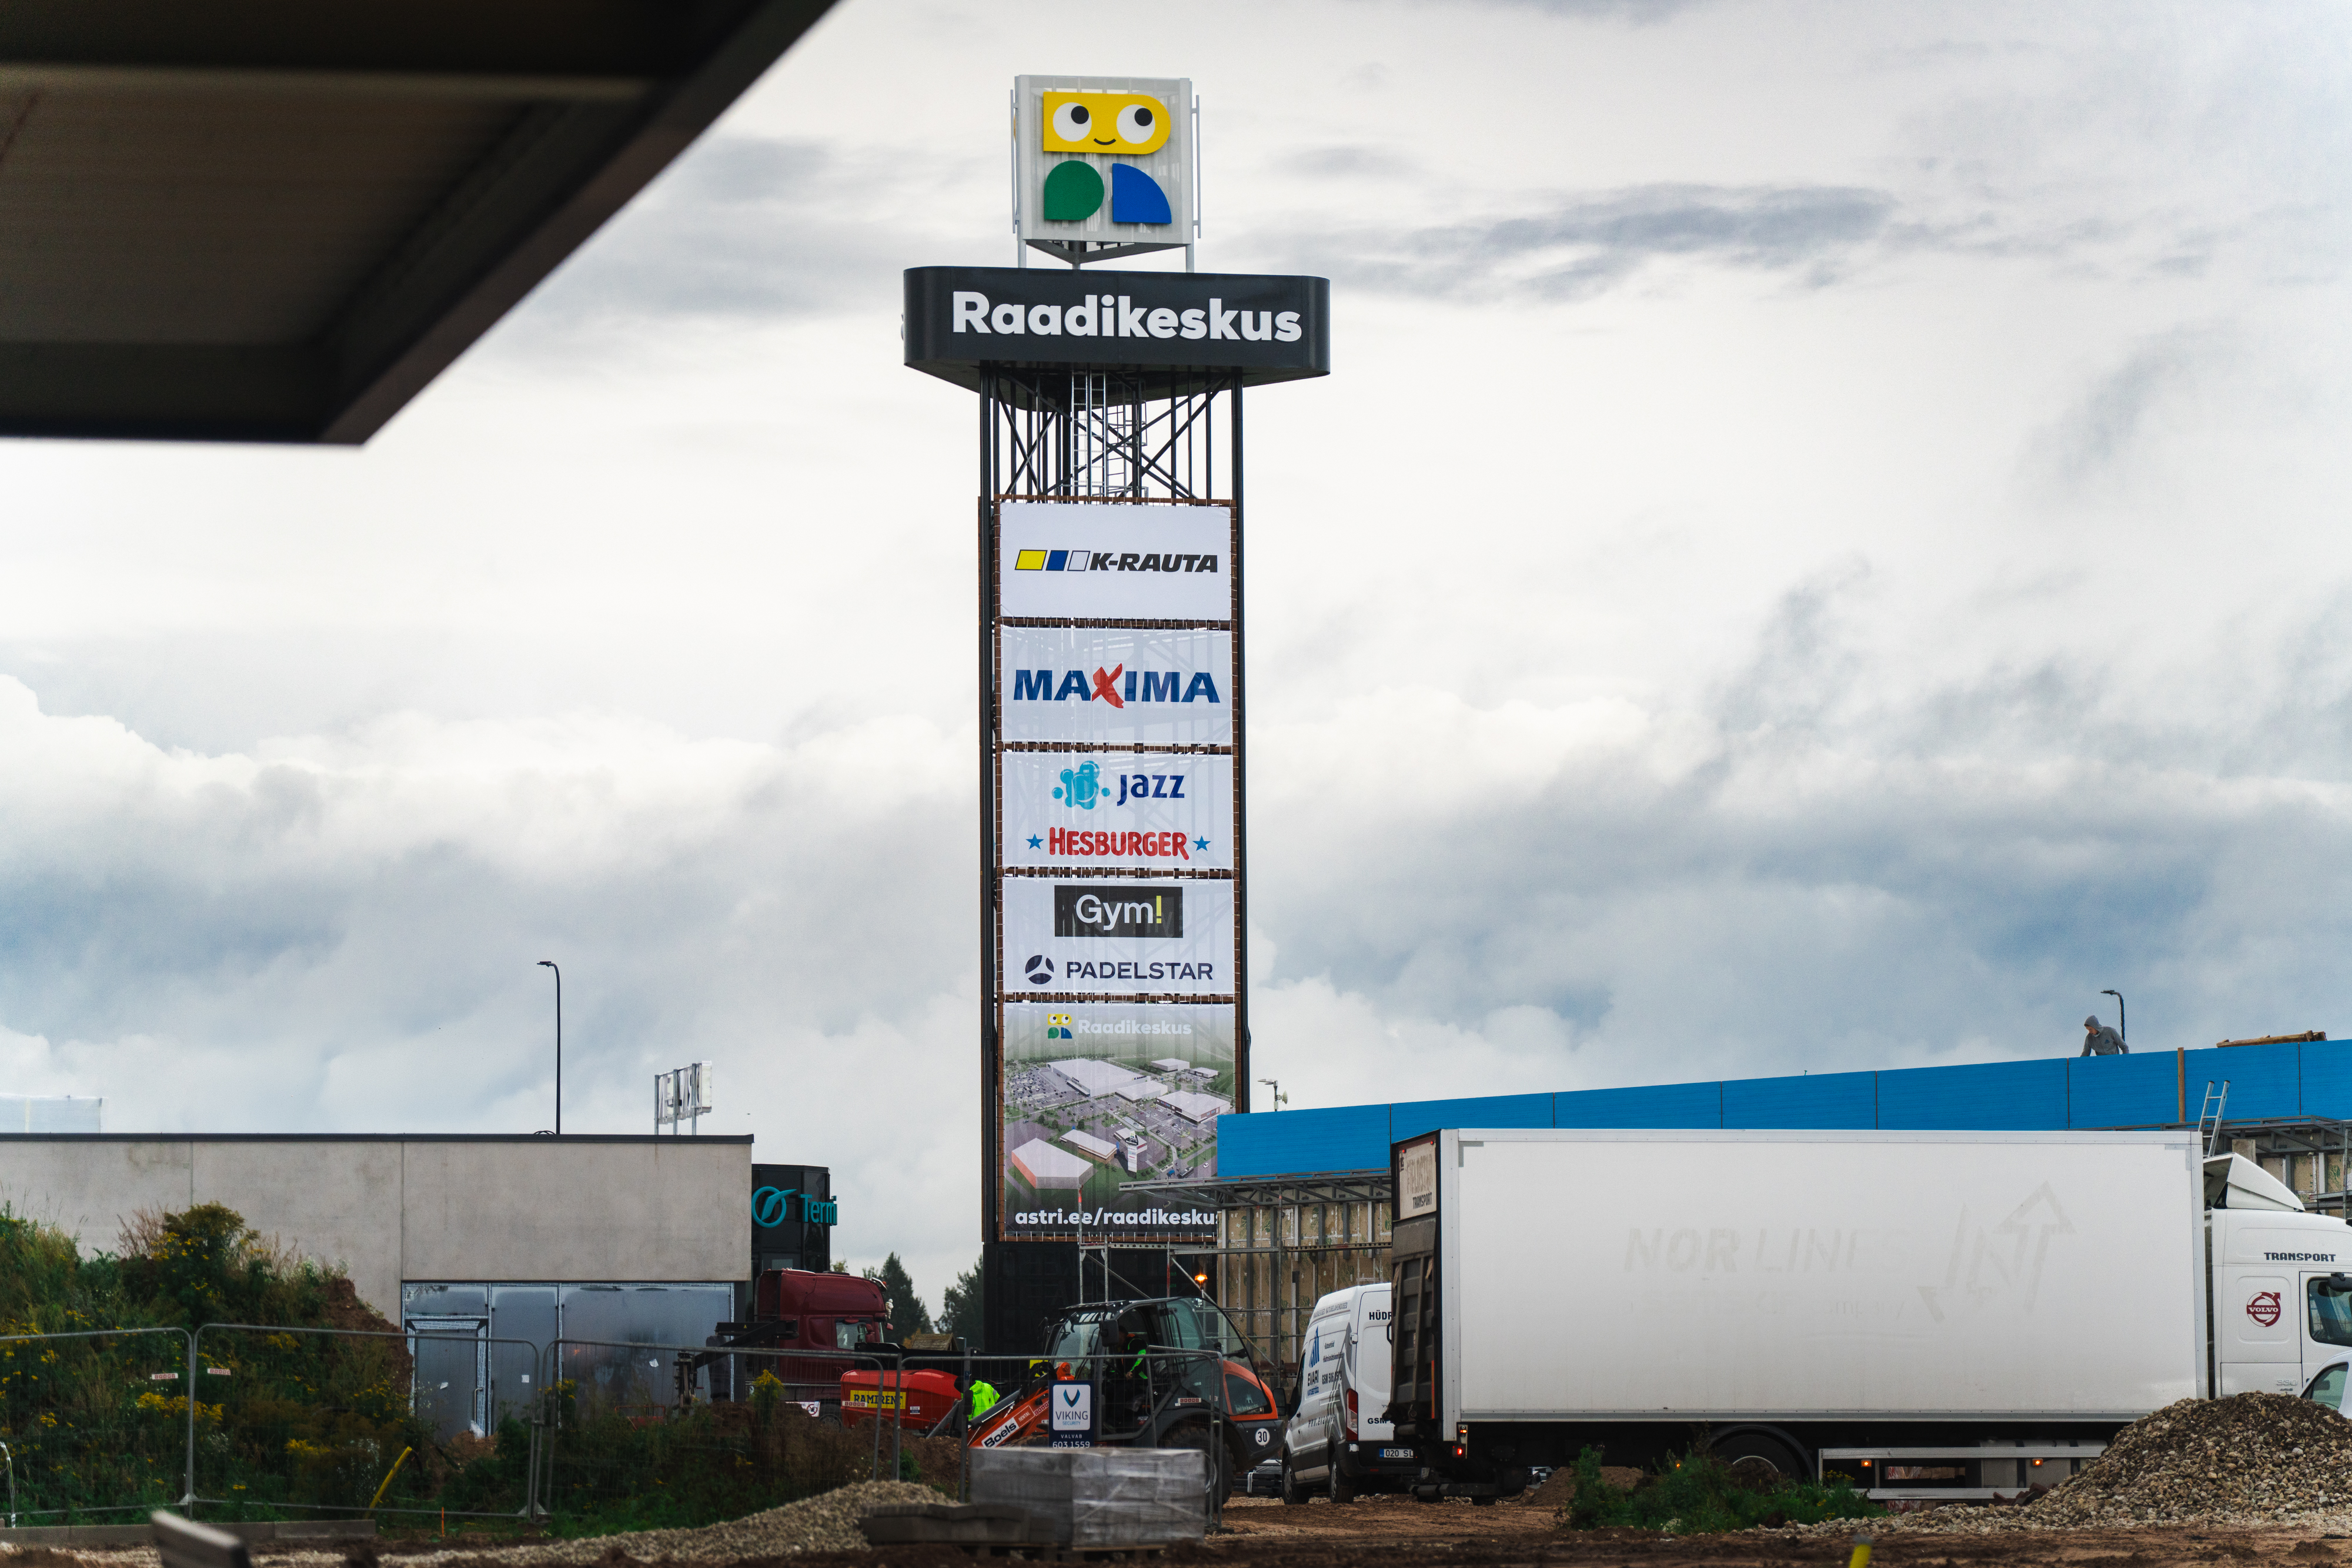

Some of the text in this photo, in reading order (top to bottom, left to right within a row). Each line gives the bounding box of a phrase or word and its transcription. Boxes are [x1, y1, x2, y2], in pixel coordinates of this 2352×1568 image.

[953, 290, 1302, 342] Raadikeskus
[1090, 553, 1218, 573] K-RAUTA
[1013, 663, 1221, 709] MAXIMA
[1117, 774, 1185, 807] jazz
[1049, 827, 1190, 860] HESBURGER
[1076, 894, 1162, 931] Gym!
[1067, 961, 1213, 980] PADELSTAR
[1078, 1018, 1192, 1035] Raadikeskus
[1412, 1192, 1432, 1210] TRANSPORT
[1015, 1207, 1218, 1226] astri.ee/raadikesku
[2264, 1252, 2336, 1262] TRANSPORT
[1307, 1369, 1319, 1387] EVARI
[1055, 1411, 1088, 1420] VIKING
[984, 1411, 1031, 1447] Boels RENTAL
[1257, 1430, 1268, 1443] 30
[1385, 1449, 1399, 1457] 020
